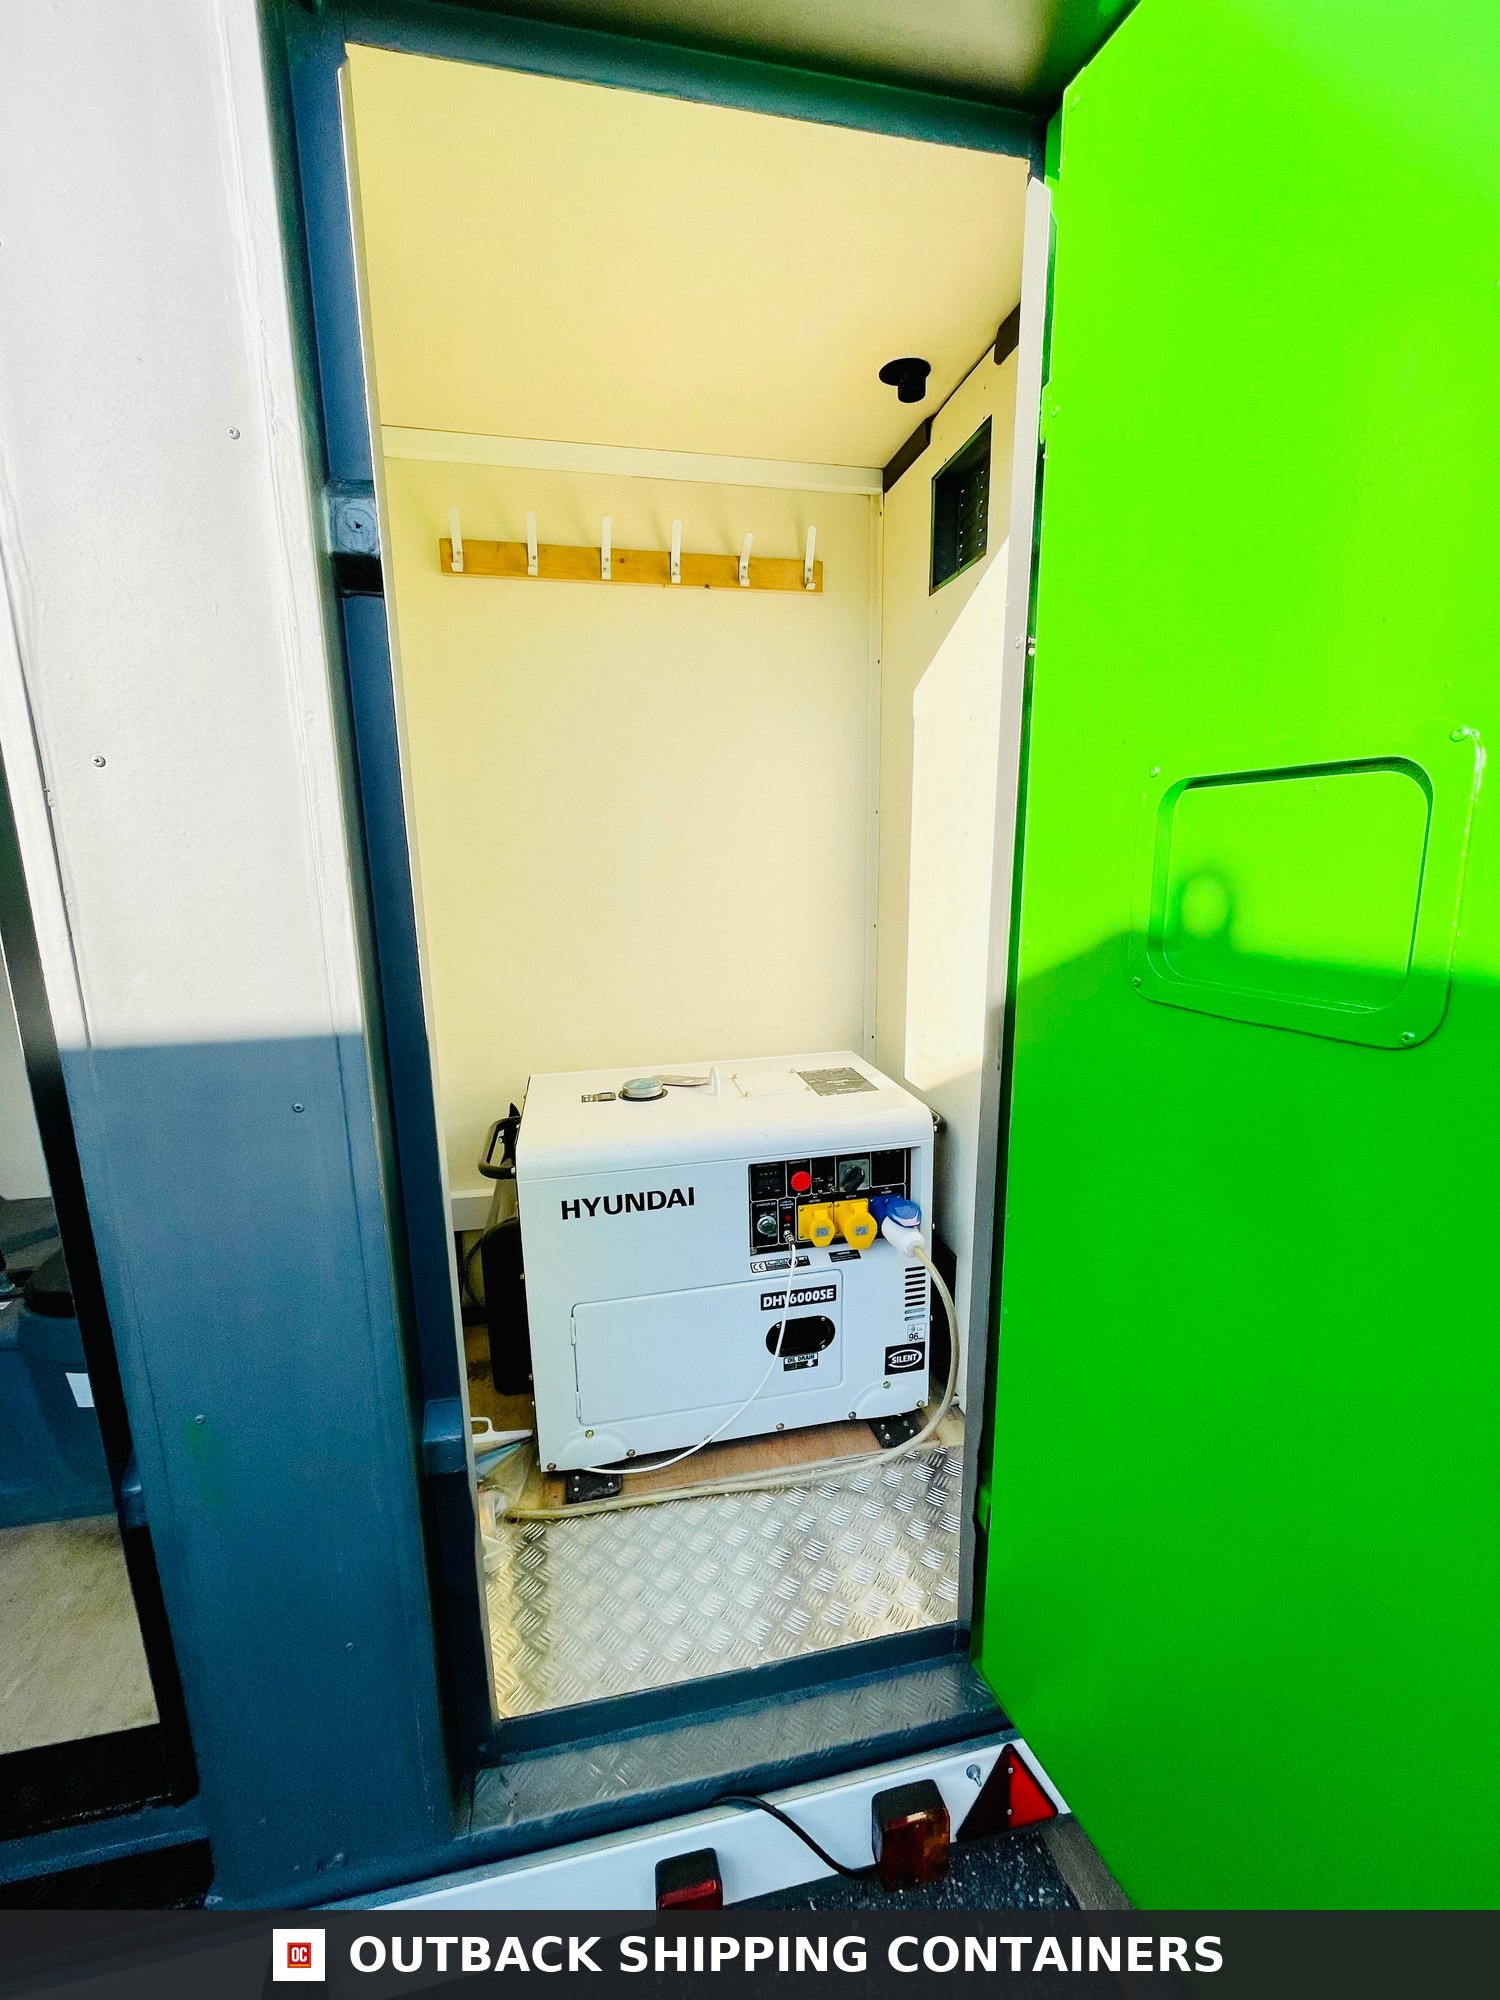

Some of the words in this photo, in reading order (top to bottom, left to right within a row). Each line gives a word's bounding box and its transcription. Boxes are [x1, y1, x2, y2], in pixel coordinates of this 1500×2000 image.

[562, 1187, 695, 1220] HYUNDAI
[908, 1332, 919, 1341] 96
[891, 1353, 917, 1364] SILENT
